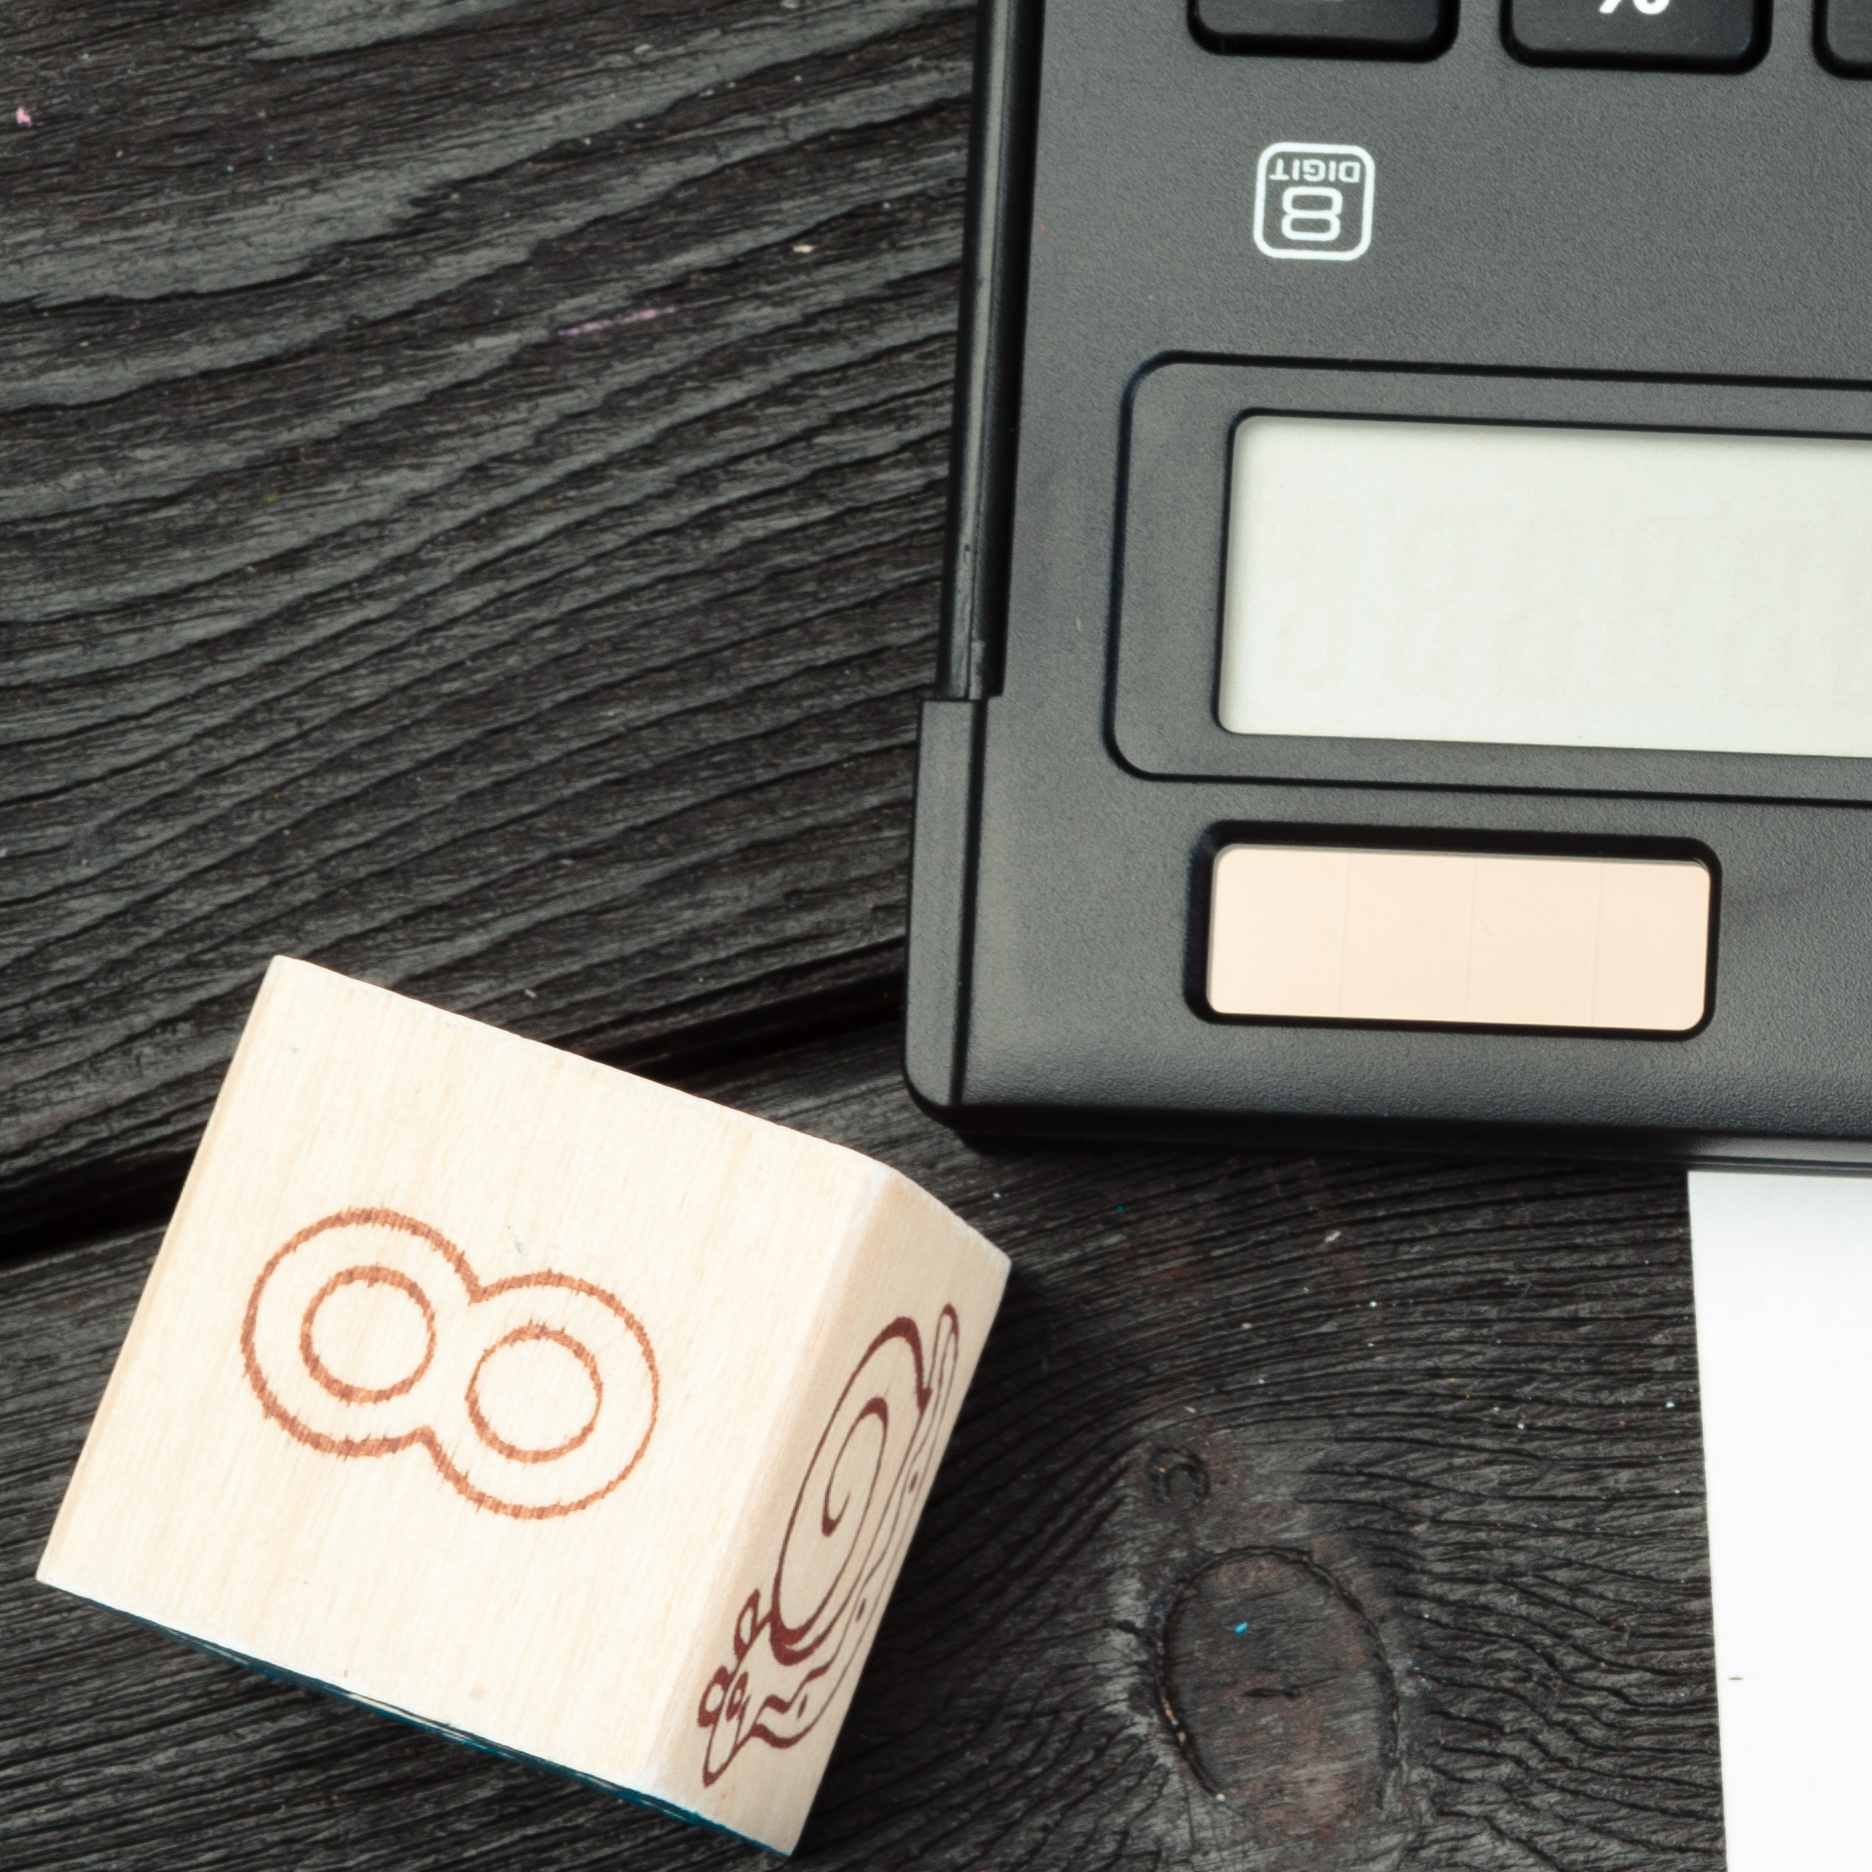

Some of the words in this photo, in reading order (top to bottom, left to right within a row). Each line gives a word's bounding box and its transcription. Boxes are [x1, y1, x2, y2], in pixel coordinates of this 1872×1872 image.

[1269, 158, 1361, 184] DIGIT
[1281, 186, 1343, 242] 8
[240, 1207, 660, 1521] 8
